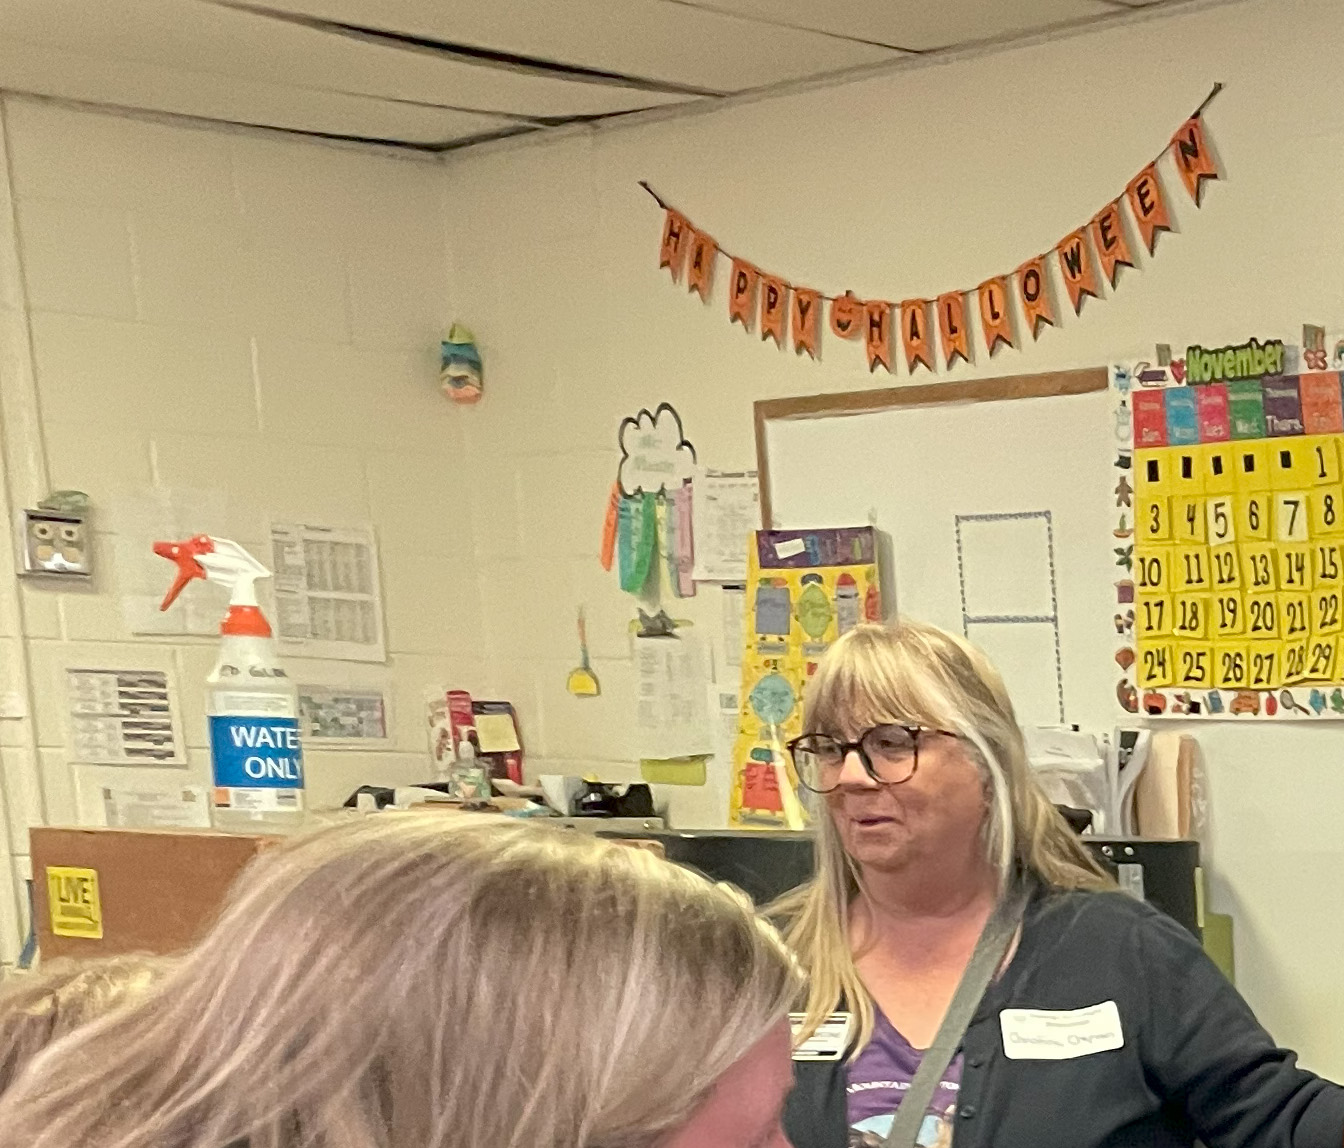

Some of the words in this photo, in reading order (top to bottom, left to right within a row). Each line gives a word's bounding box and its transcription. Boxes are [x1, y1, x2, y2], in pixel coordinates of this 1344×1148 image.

[667, 218, 809, 331] HAPPY
[868, 129, 1199, 341] HALLOWEEN
[1186, 338, 1283, 385] November
[1316, 446, 1327, 477] 1
[1150, 504, 1160, 533] 3
[1187, 504, 1195, 535] 4
[1214, 502, 1228, 538] 5
[1249, 500, 1259, 530] 6
[1284, 501, 1299, 535] 7
[1324, 495, 1335, 525] 8
[1140, 558, 1161, 586] 10
[1185, 554, 1204, 584] 11
[1215, 552, 1235, 584] 12
[1250, 554, 1270, 585] 13
[1286, 553, 1305, 585] 14
[1320, 547, 1338, 579] 15
[1144, 601, 1164, 630] 17
[1180, 601, 1199, 630] 18
[1219, 598, 1237, 628] 19
[1251, 601, 1273, 631] 20
[1287, 601, 1305, 634] 21
[1320, 595, 1338, 629] 22
[1144, 648, 1167, 681] 24
[1183, 652, 1206, 681] 25
[1222, 652, 1243, 683] 26
[1254, 654, 1274, 684] 27
[1286, 646, 1304, 678] 28
[1310, 643, 1332, 675] 29
[230, 726, 301, 749] WATE
